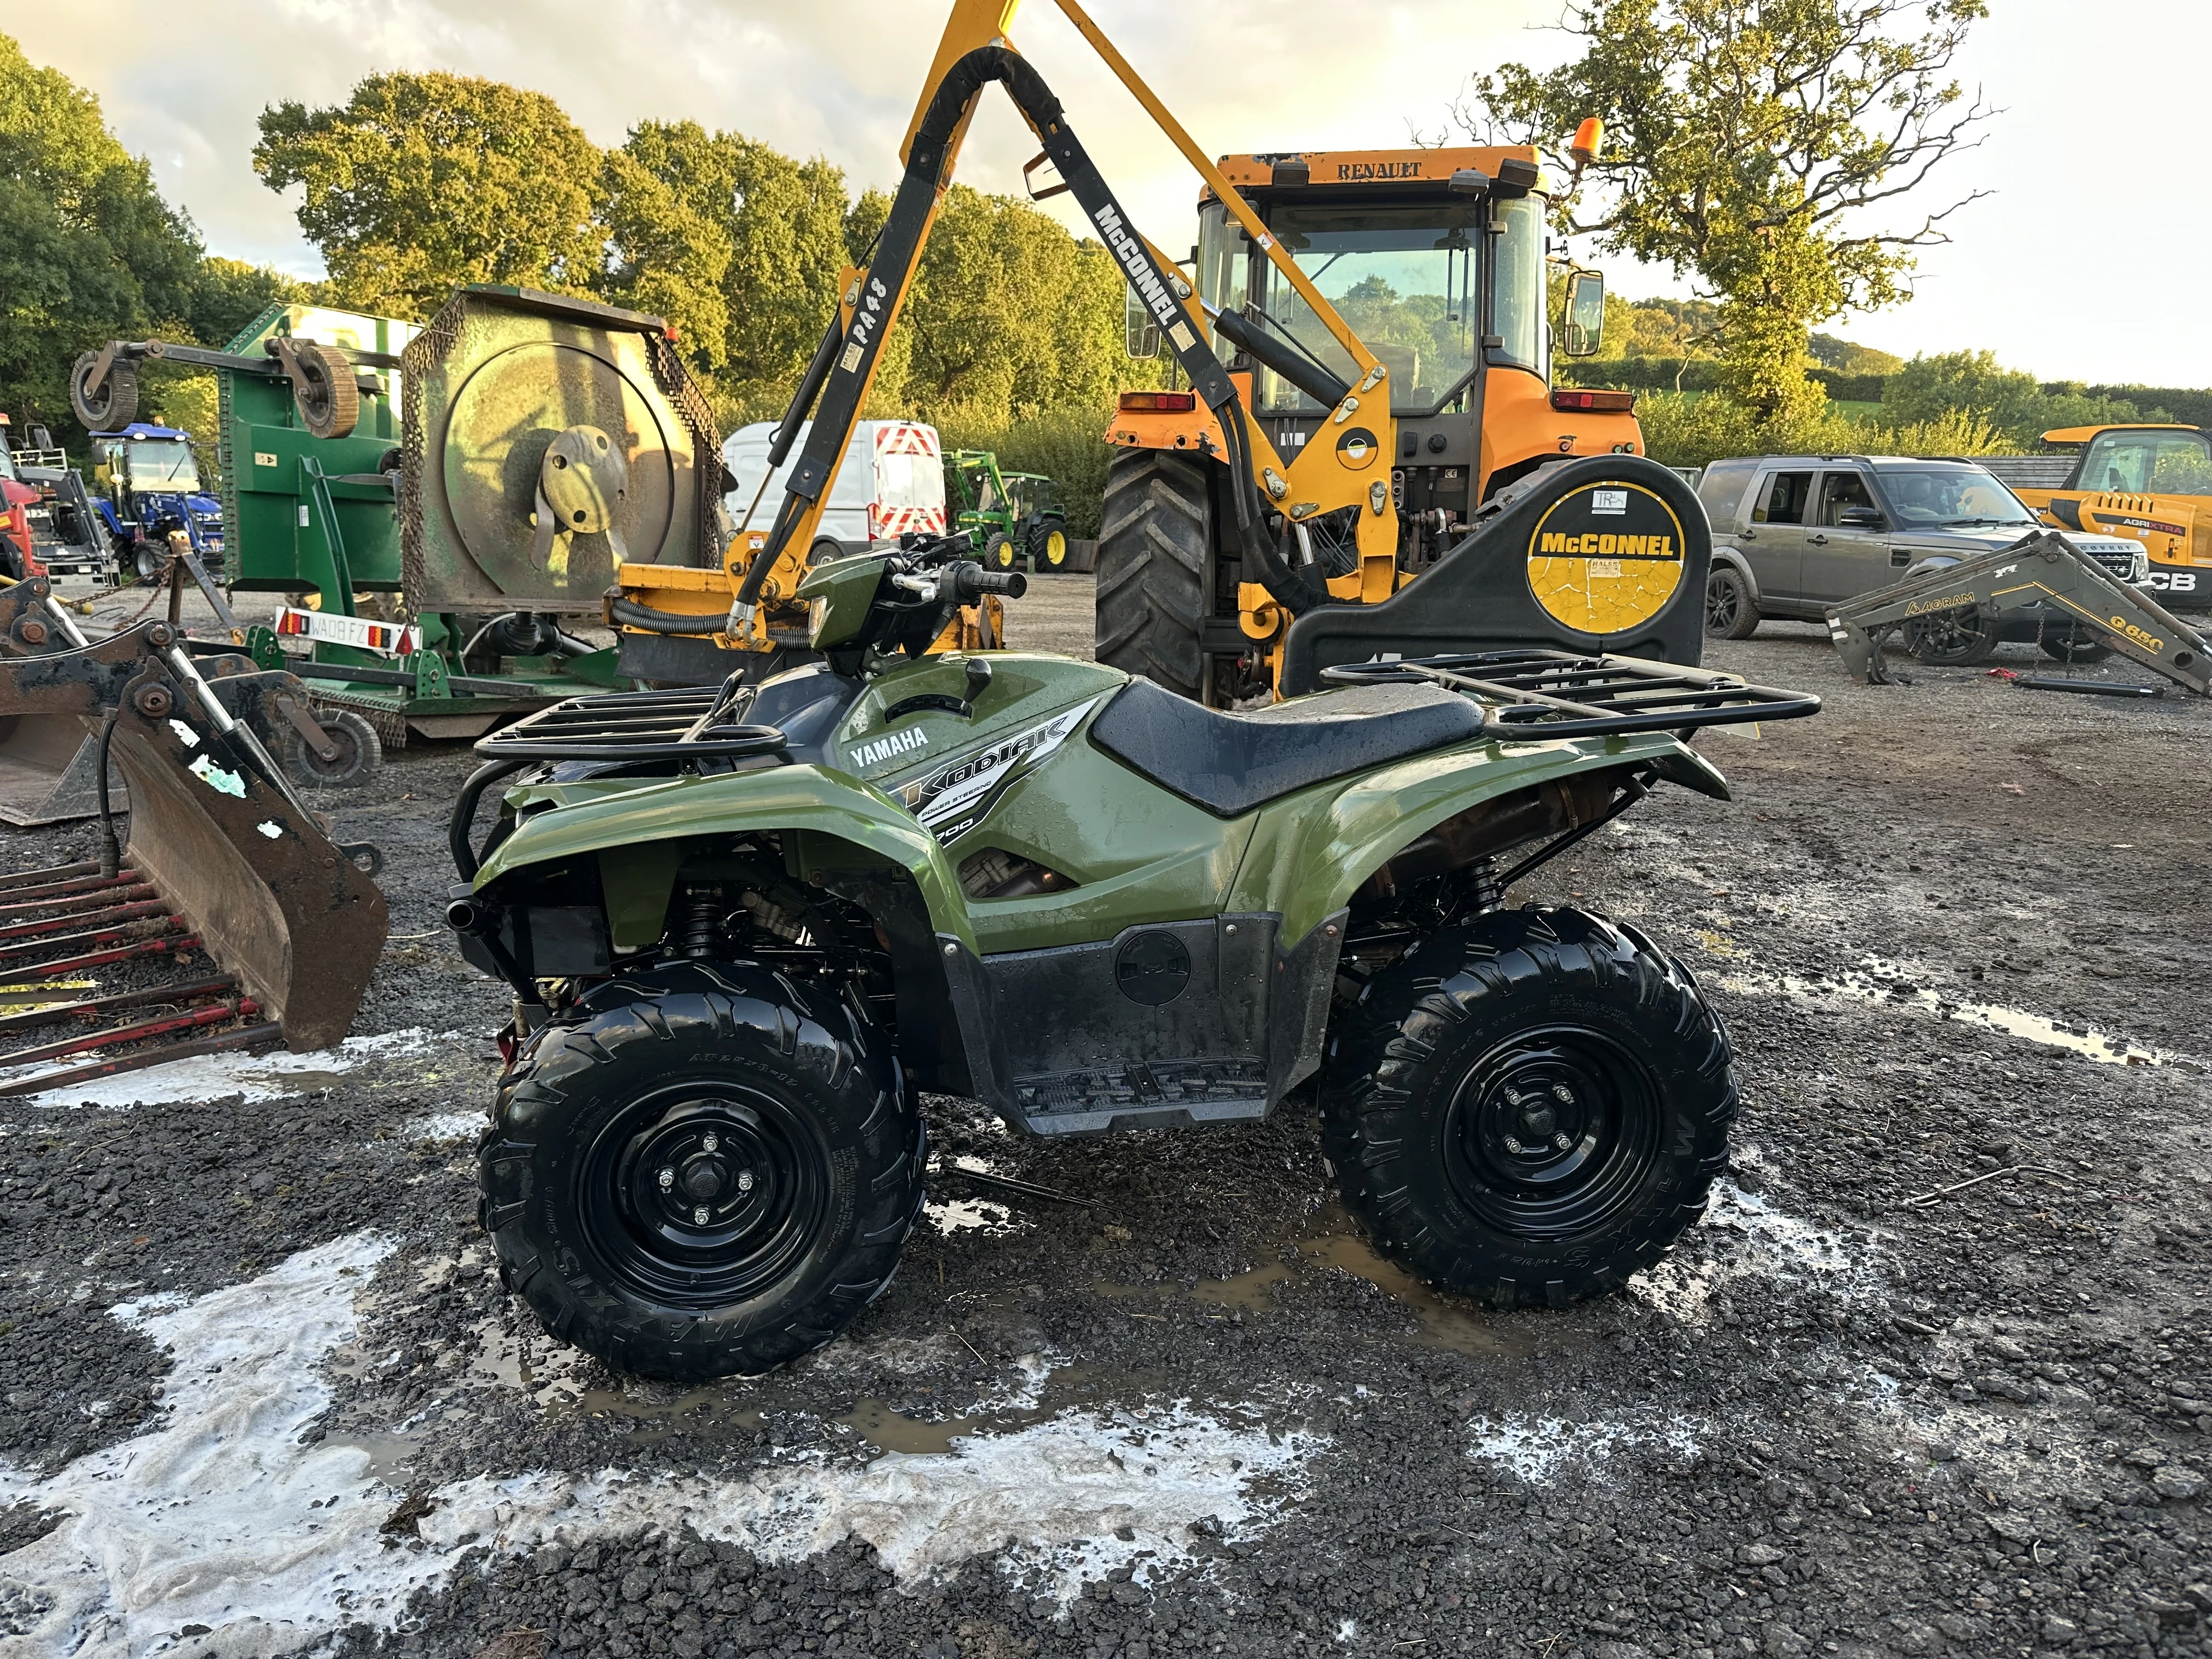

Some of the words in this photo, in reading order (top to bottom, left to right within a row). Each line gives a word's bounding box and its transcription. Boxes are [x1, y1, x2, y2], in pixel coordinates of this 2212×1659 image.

[1337, 162, 1421, 180] RENAULT
[2148, 572, 2196, 591] CB
[1921, 591, 1975, 613] AGRAM
[849, 727, 928, 768] YAMAHA
[905, 715, 1069, 808] KODIAK
[922, 800, 950, 817] POWER
[952, 780, 992, 803] STEERING
